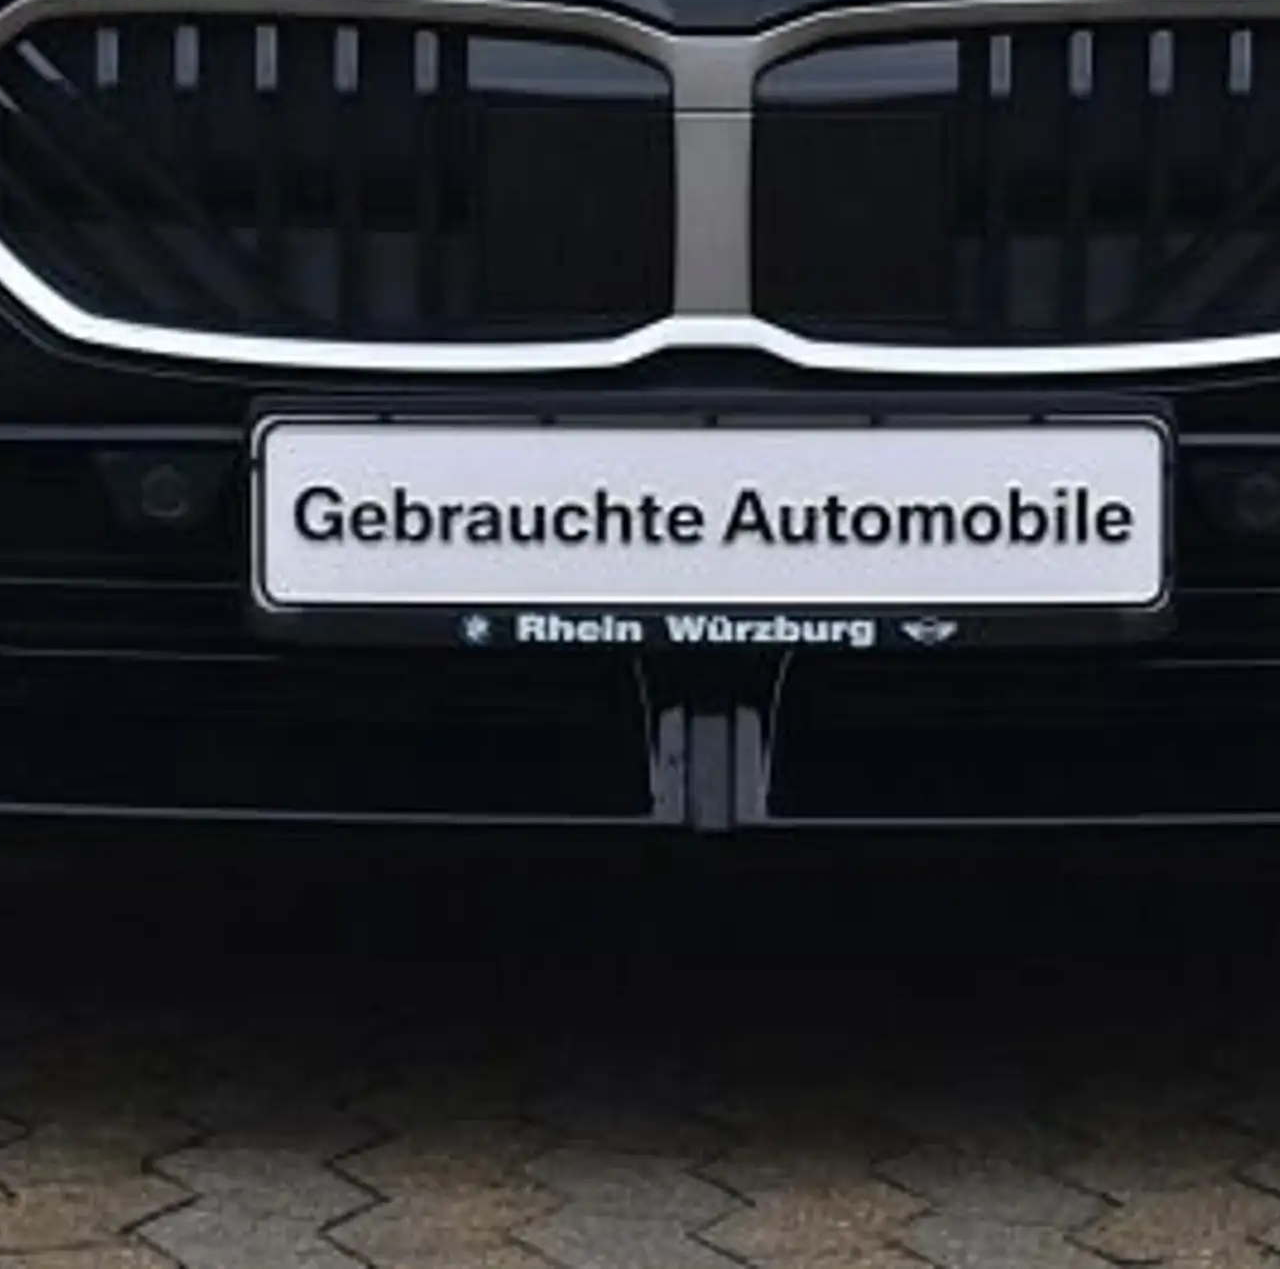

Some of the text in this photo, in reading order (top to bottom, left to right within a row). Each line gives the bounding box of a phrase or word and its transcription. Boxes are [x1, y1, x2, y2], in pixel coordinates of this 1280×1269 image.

[293, 486, 1134, 546] Gebrauchte Automobile
[517, 614, 875, 647] Rhein Würzburg
